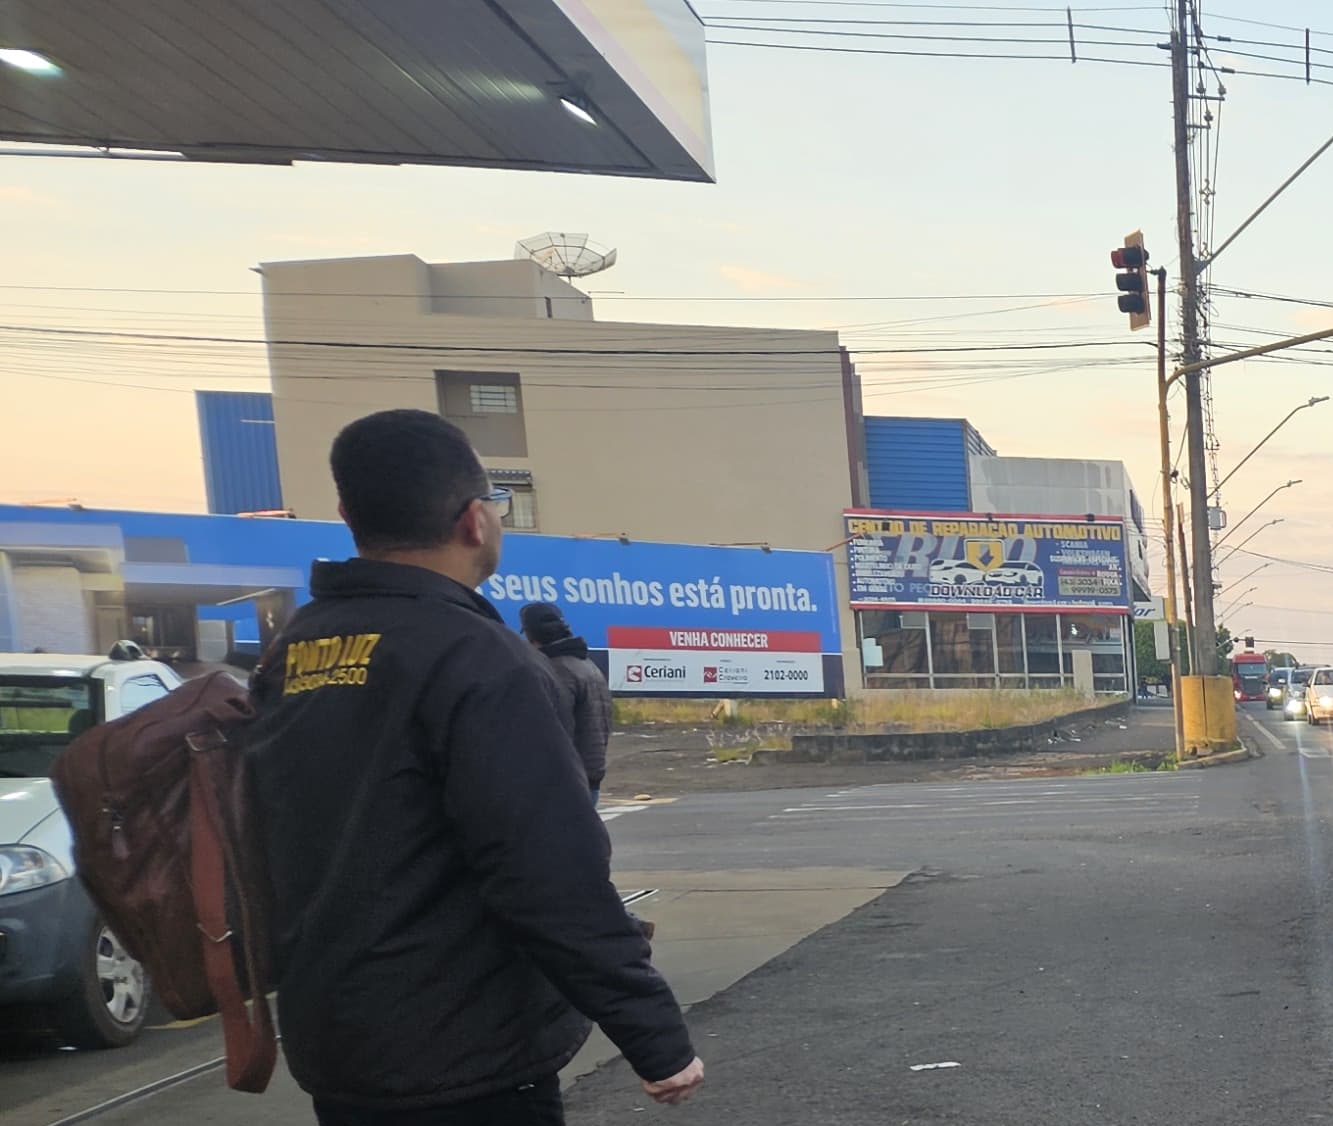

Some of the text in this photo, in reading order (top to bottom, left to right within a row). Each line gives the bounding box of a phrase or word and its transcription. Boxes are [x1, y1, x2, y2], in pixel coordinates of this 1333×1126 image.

[848, 520, 904, 534] CENTO
[1023, 525, 1121, 540] AUTOMOTIVO
[490, 573, 817, 615] seus sonhos está pronta.
[931, 585, 1044, 599] DOWNLOAD CAR
[669, 631, 768, 649] VENHA CONHECER
[338, 633, 382, 667] LUZ
[644, 665, 687, 679] Ceriani
[764, 670, 808, 681] 2102-0000
